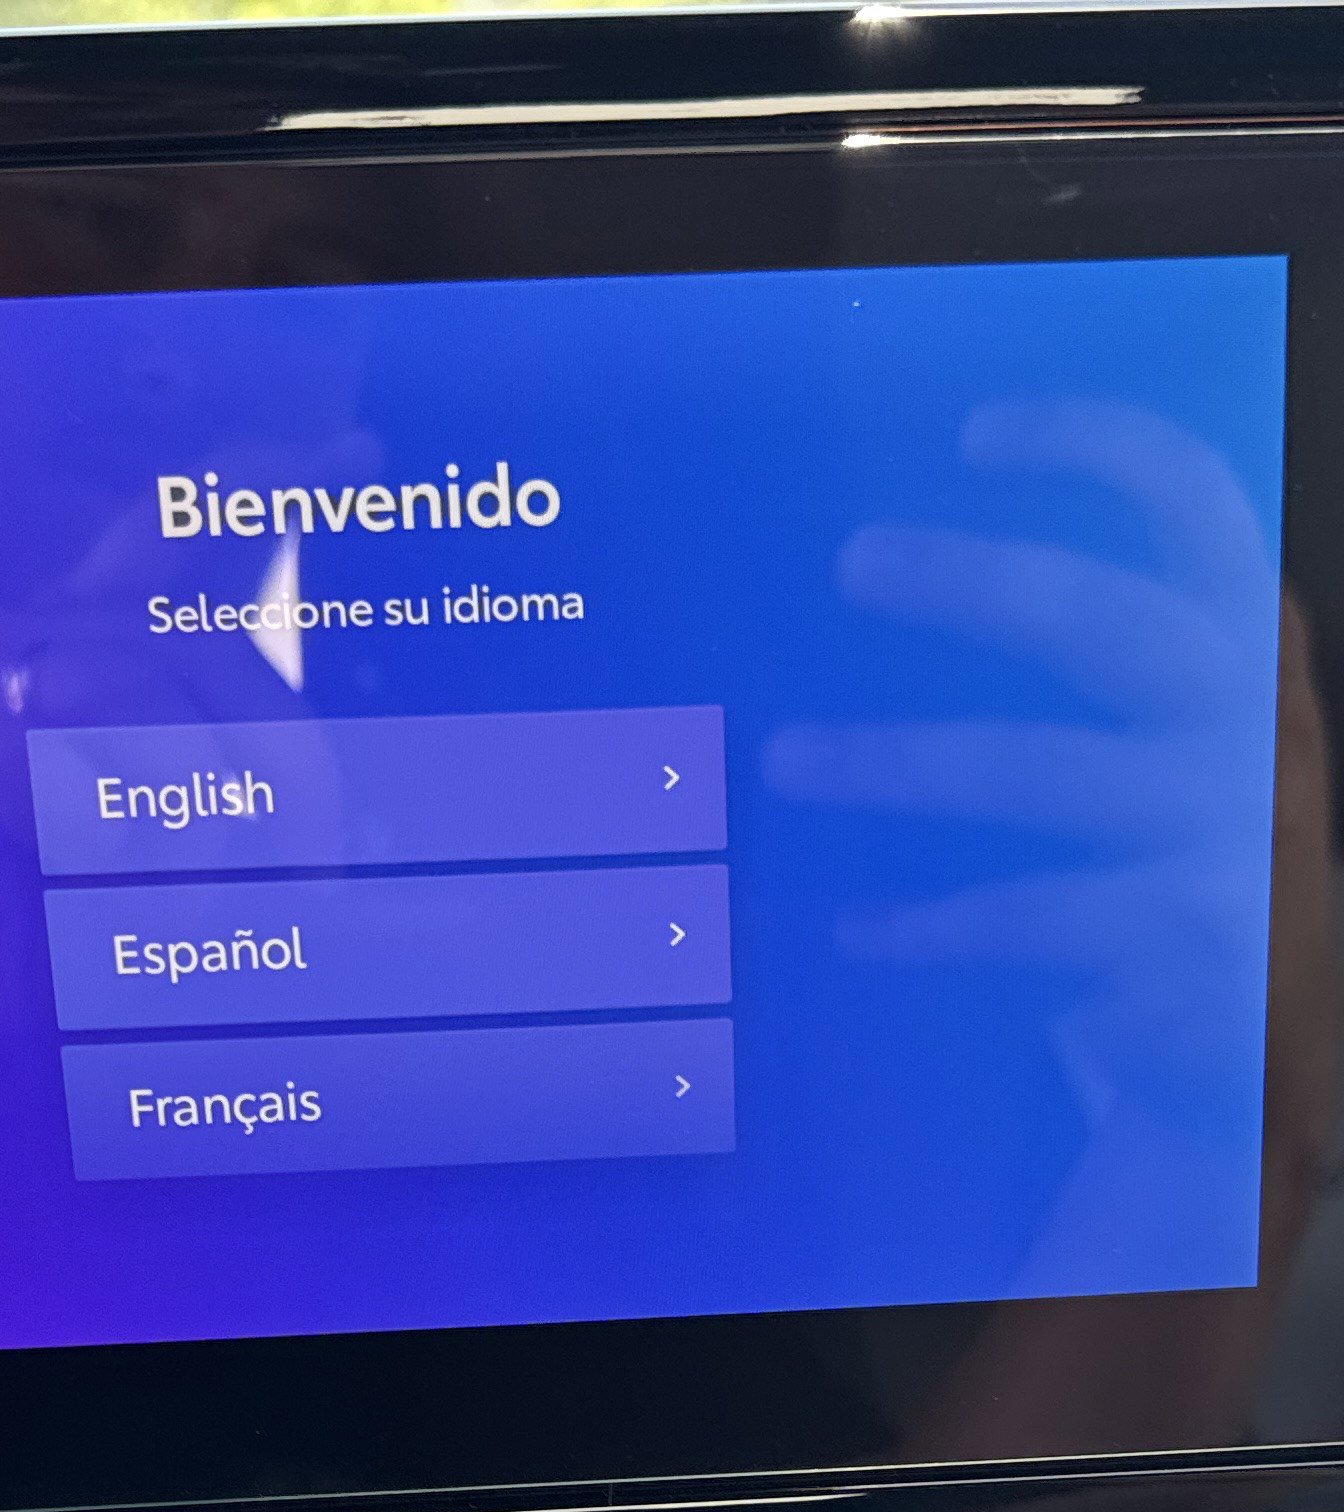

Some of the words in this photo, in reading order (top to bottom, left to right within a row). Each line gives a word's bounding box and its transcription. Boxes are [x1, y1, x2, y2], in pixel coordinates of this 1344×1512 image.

[156, 462, 562, 539] Bienvenido
[147, 592, 374, 634] Seleccione
[383, 594, 430, 626] su
[442, 584, 586, 623] idioma
[96, 770, 275, 831] English
[112, 926, 307, 985] Español
[128, 1081, 322, 1135] Français
